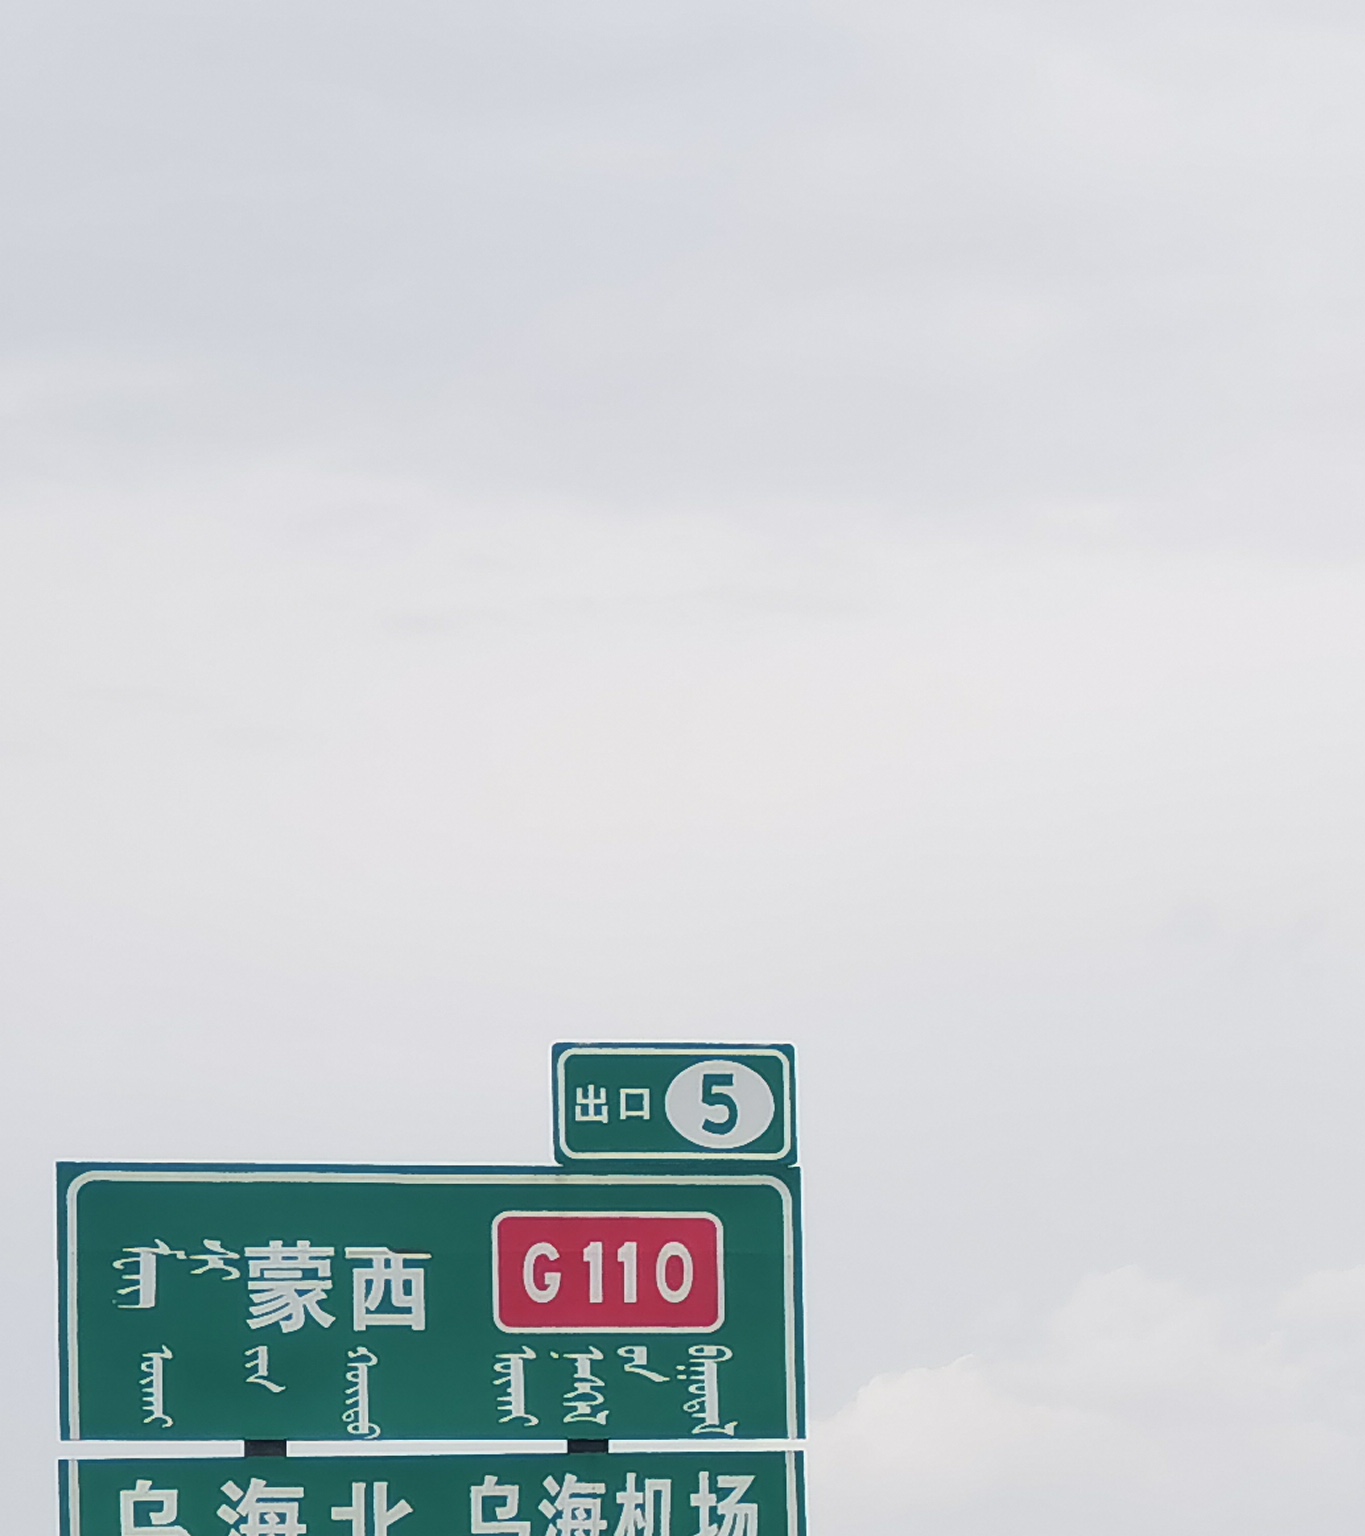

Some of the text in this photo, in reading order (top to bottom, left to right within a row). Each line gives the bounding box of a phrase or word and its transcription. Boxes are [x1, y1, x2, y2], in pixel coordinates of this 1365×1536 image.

[576, 1072, 740, 1136] 出口 5
[245, 1240, 432, 1333] 蒙西
[523, 1241, 694, 1304] G110
